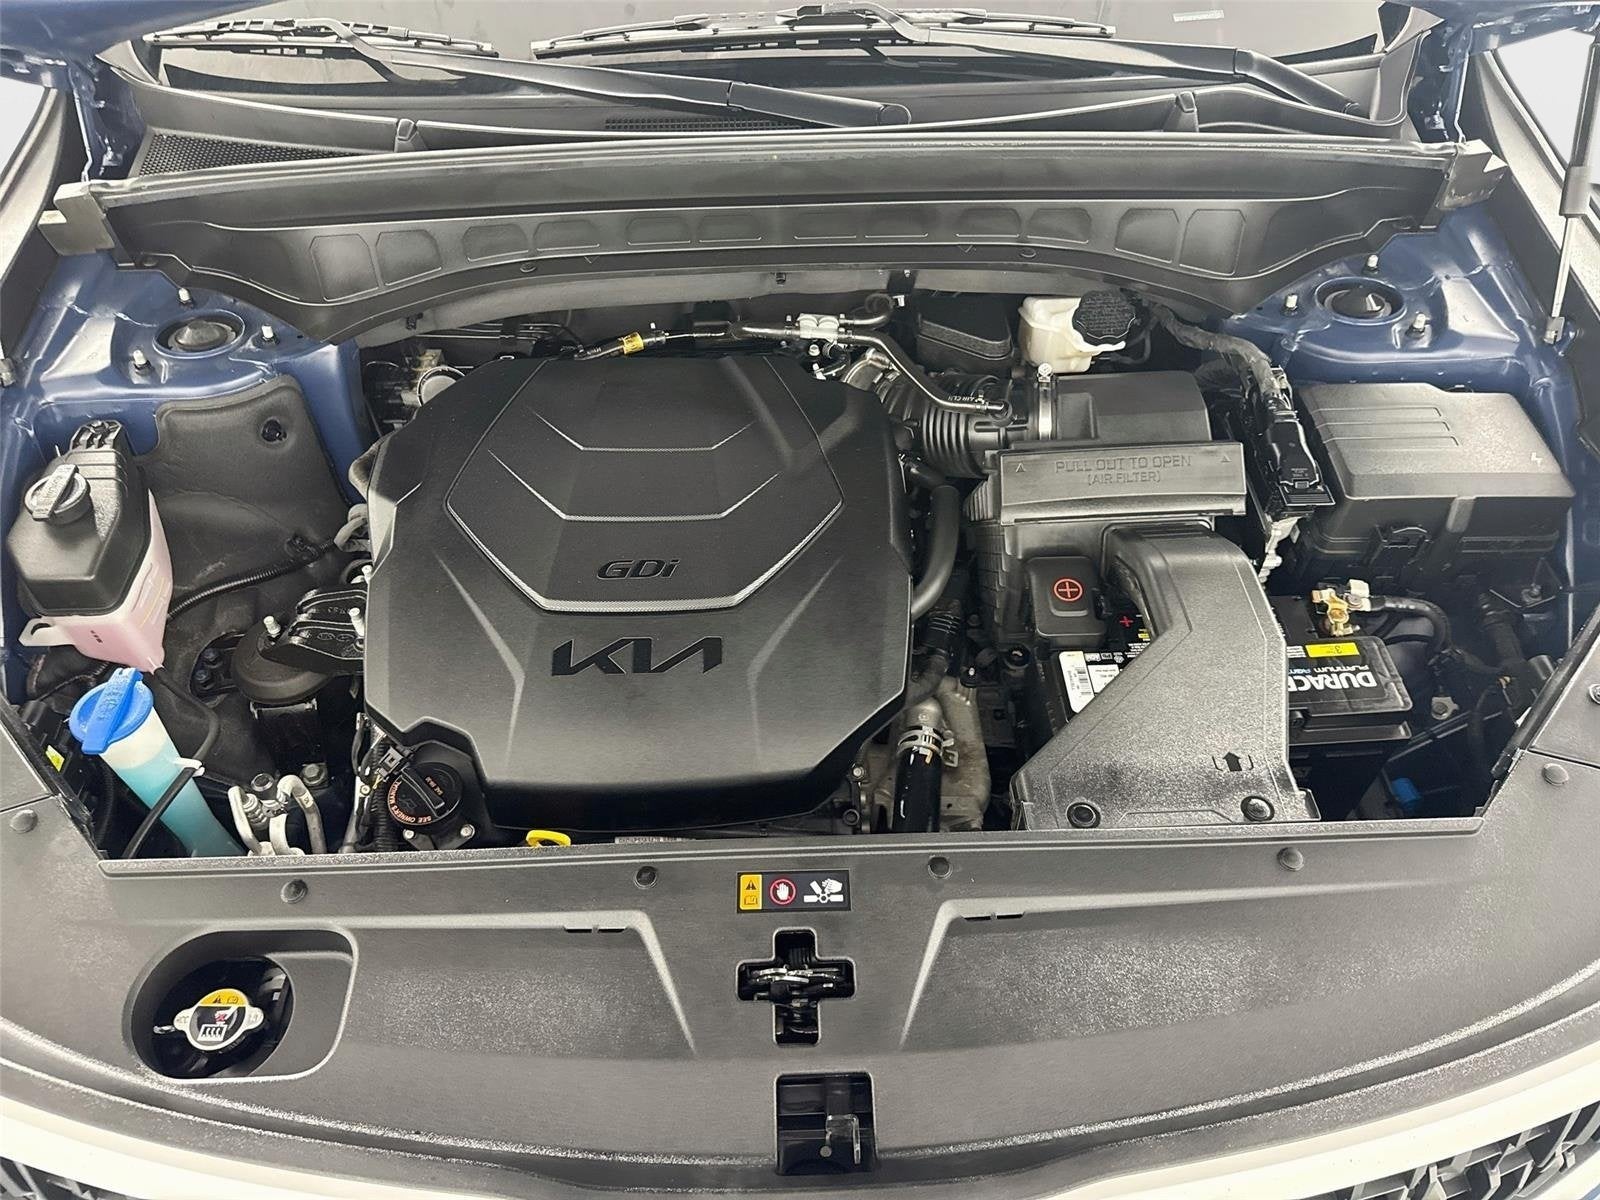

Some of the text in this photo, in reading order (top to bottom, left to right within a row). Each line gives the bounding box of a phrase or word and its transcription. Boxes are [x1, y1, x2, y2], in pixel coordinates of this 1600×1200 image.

[1055, 455, 1191, 473] PULL OUT TO OPEN
[1087, 471, 1161, 486] (AIR FILTER)
[597, 559, 680, 580] GDi
[552, 636, 722, 676] KIA
[1287, 671, 1377, 692] DURAC
